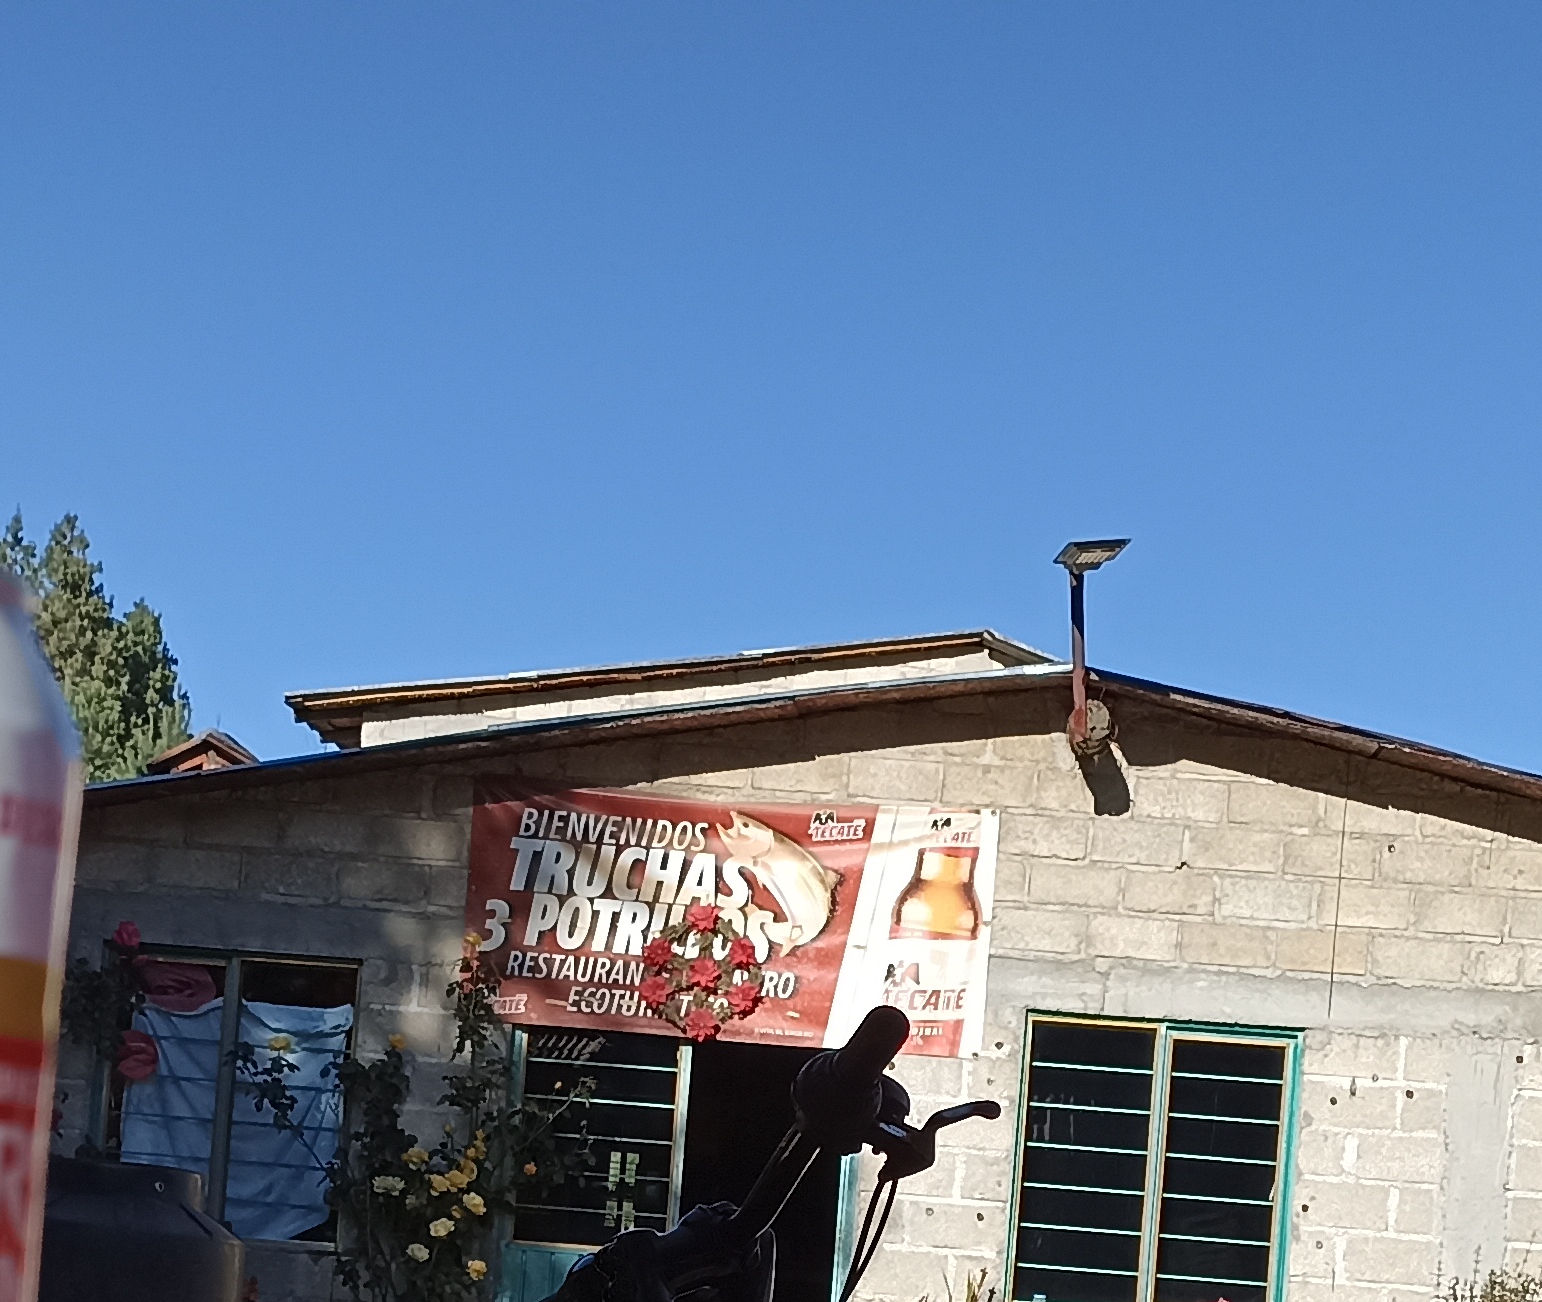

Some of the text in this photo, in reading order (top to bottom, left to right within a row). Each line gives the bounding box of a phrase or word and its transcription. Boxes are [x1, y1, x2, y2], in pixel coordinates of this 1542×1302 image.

[519, 807, 708, 851] BIENVENIDOS
[812, 823, 862, 838] TECATE
[509, 837, 751, 908] TRUCHAS
[480, 899, 511, 951] 3
